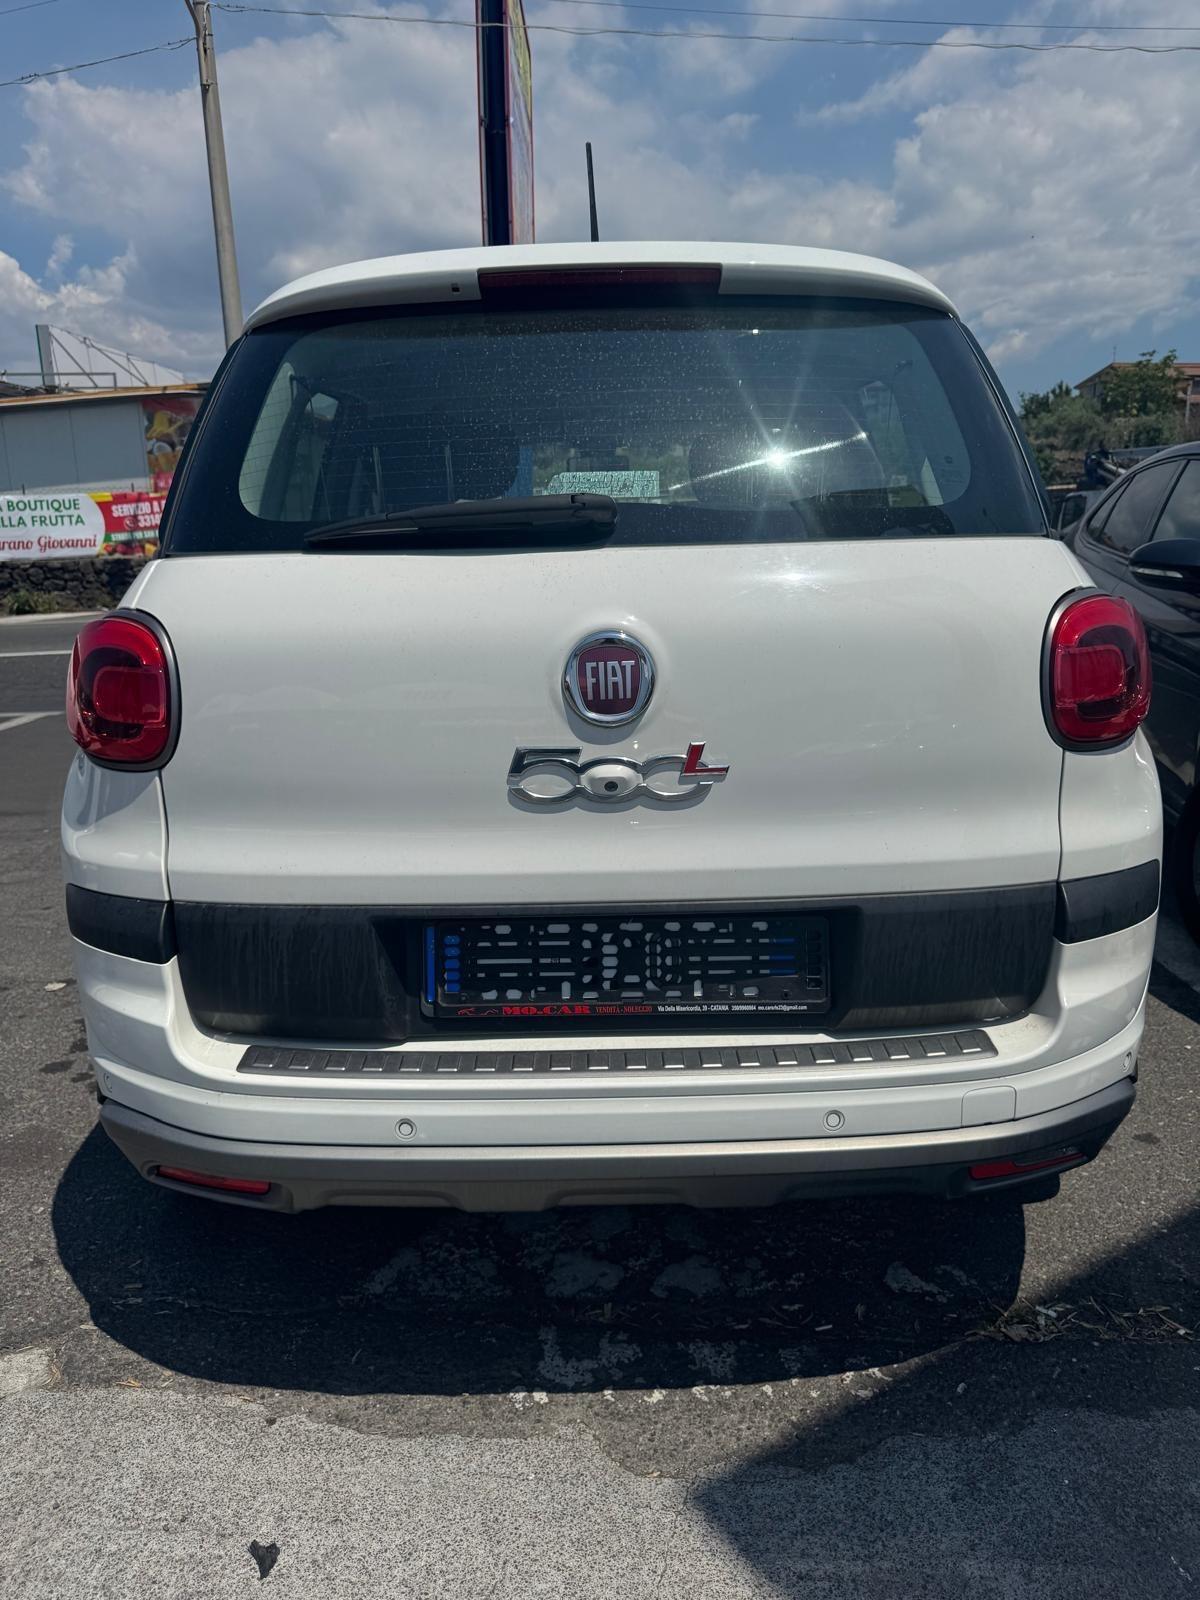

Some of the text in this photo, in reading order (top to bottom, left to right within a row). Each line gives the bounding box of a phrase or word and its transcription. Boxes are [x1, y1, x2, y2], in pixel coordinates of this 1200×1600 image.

[7, 498, 80, 513] BOUTIQUE
[111, 502, 151, 517] SERVIZIO
[0, 514, 85, 528] LLA FRUTTA
[0, 540, 33, 551] rano
[37, 535, 96, 553] Giovanni
[585, 660, 635, 701] FIAT
[502, 1004, 591, 1016] MO.CAR
